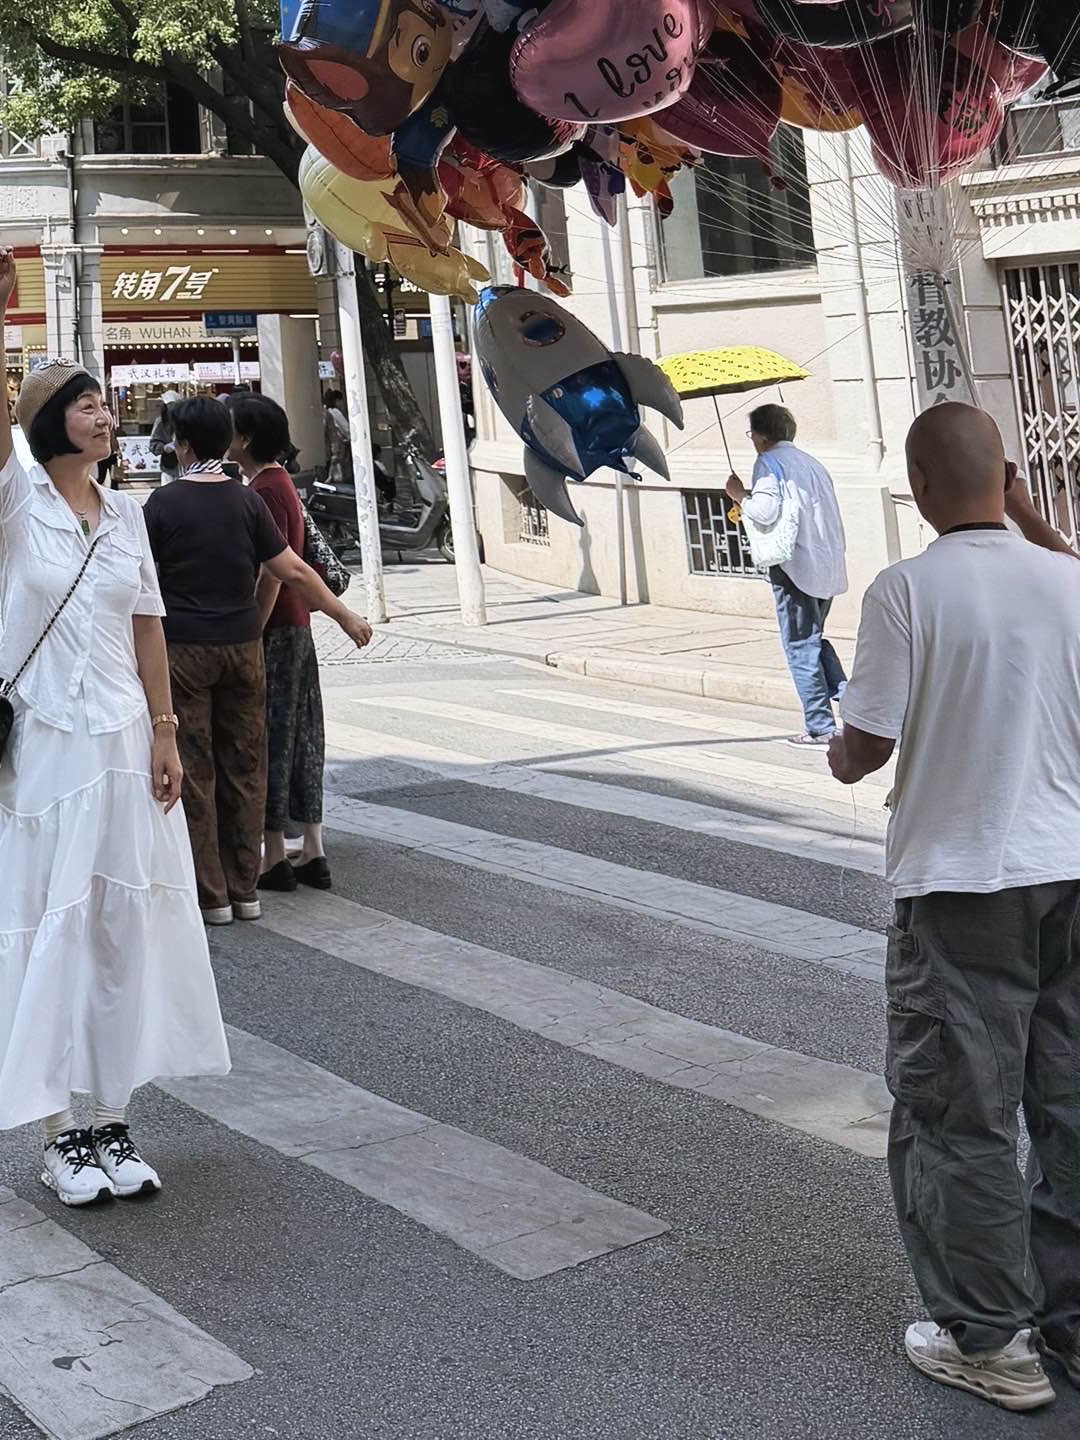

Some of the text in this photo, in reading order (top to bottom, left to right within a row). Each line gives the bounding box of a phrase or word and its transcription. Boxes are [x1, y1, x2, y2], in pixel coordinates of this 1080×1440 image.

[597, 12, 683, 98] love
[112, 265, 213, 301] 转角7号
[139, 326, 192, 339] WUHAN
